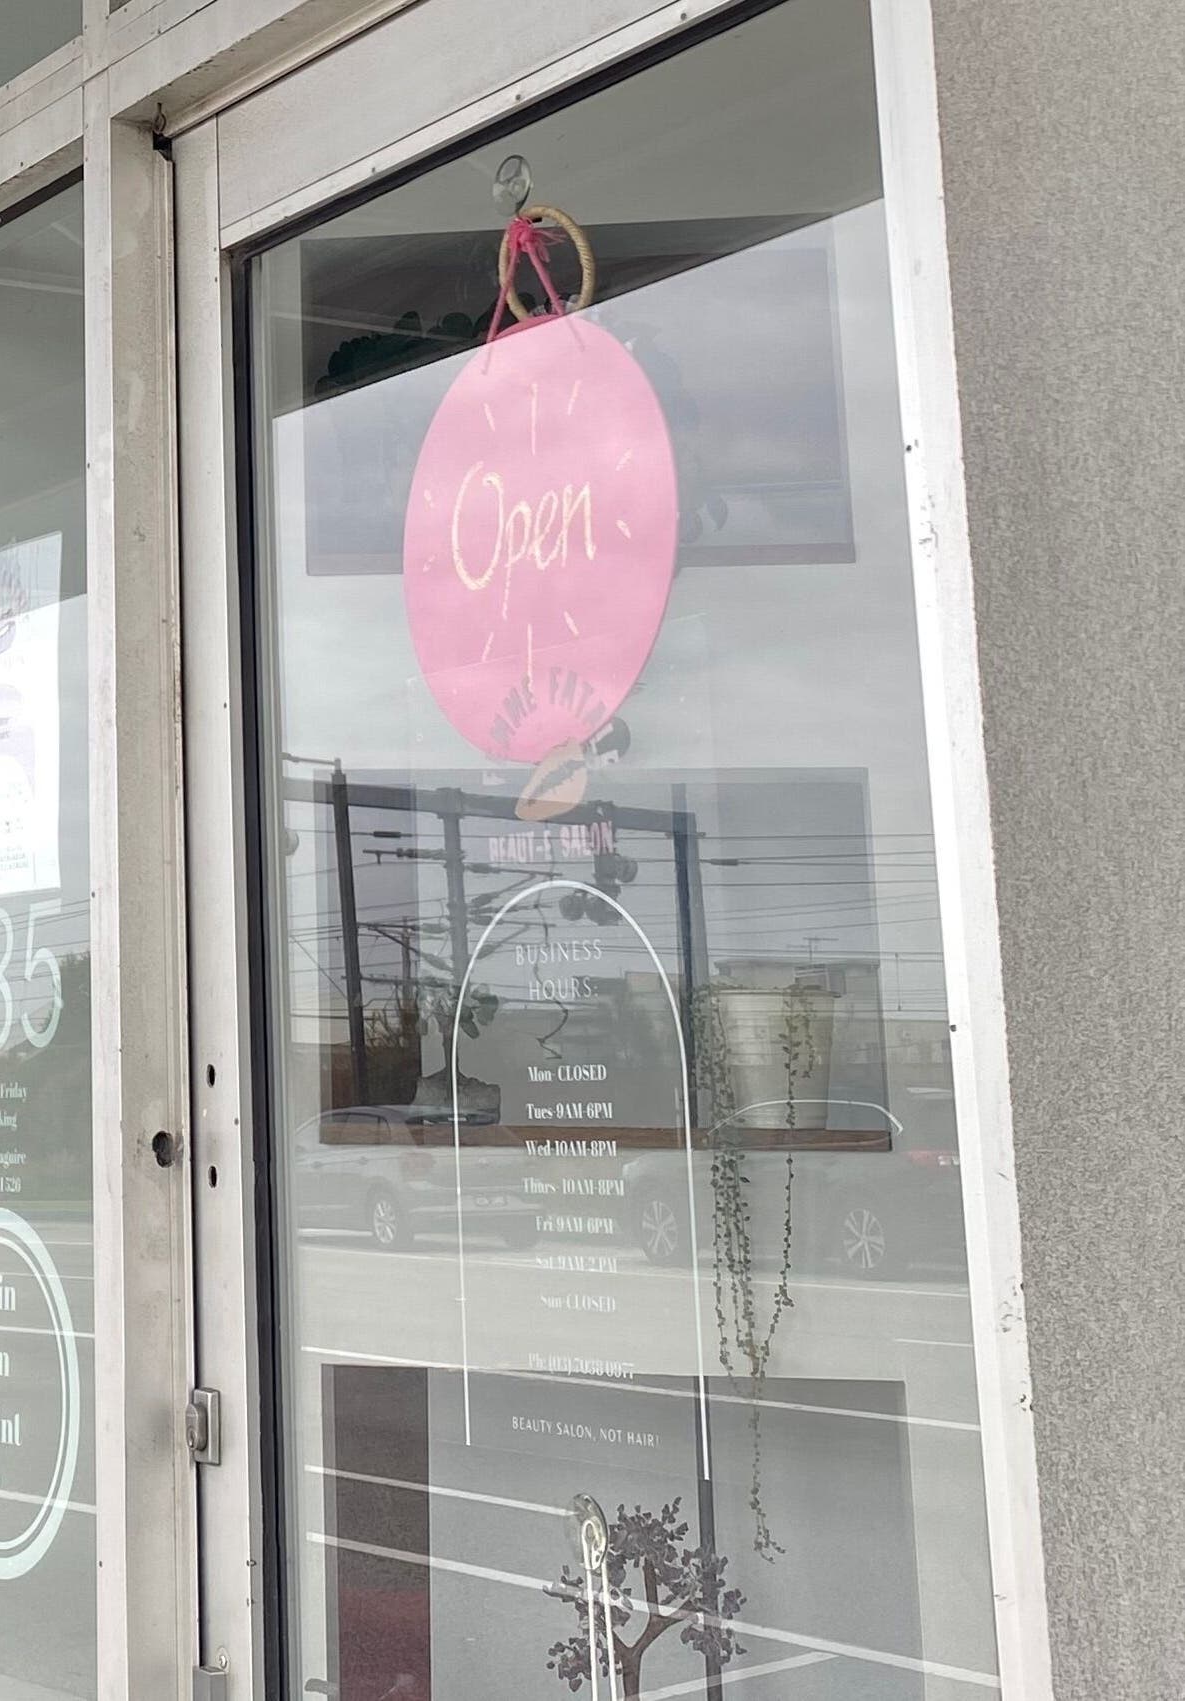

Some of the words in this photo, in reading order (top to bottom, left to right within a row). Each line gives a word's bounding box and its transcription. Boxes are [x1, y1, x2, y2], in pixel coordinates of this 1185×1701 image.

[451, 460, 597, 621] Open
[559, 820, 616, 859] SALON
[515, 938, 603, 966] BUSINESS
[529, 976, 600, 1001] HOURS:
[557, 1064, 607, 1081] CLOSED
[0, 1081, 27, 1103] Friday
[512, 1415, 552, 1434] BEAUTY
[599, 1428, 622, 1443] NOT
